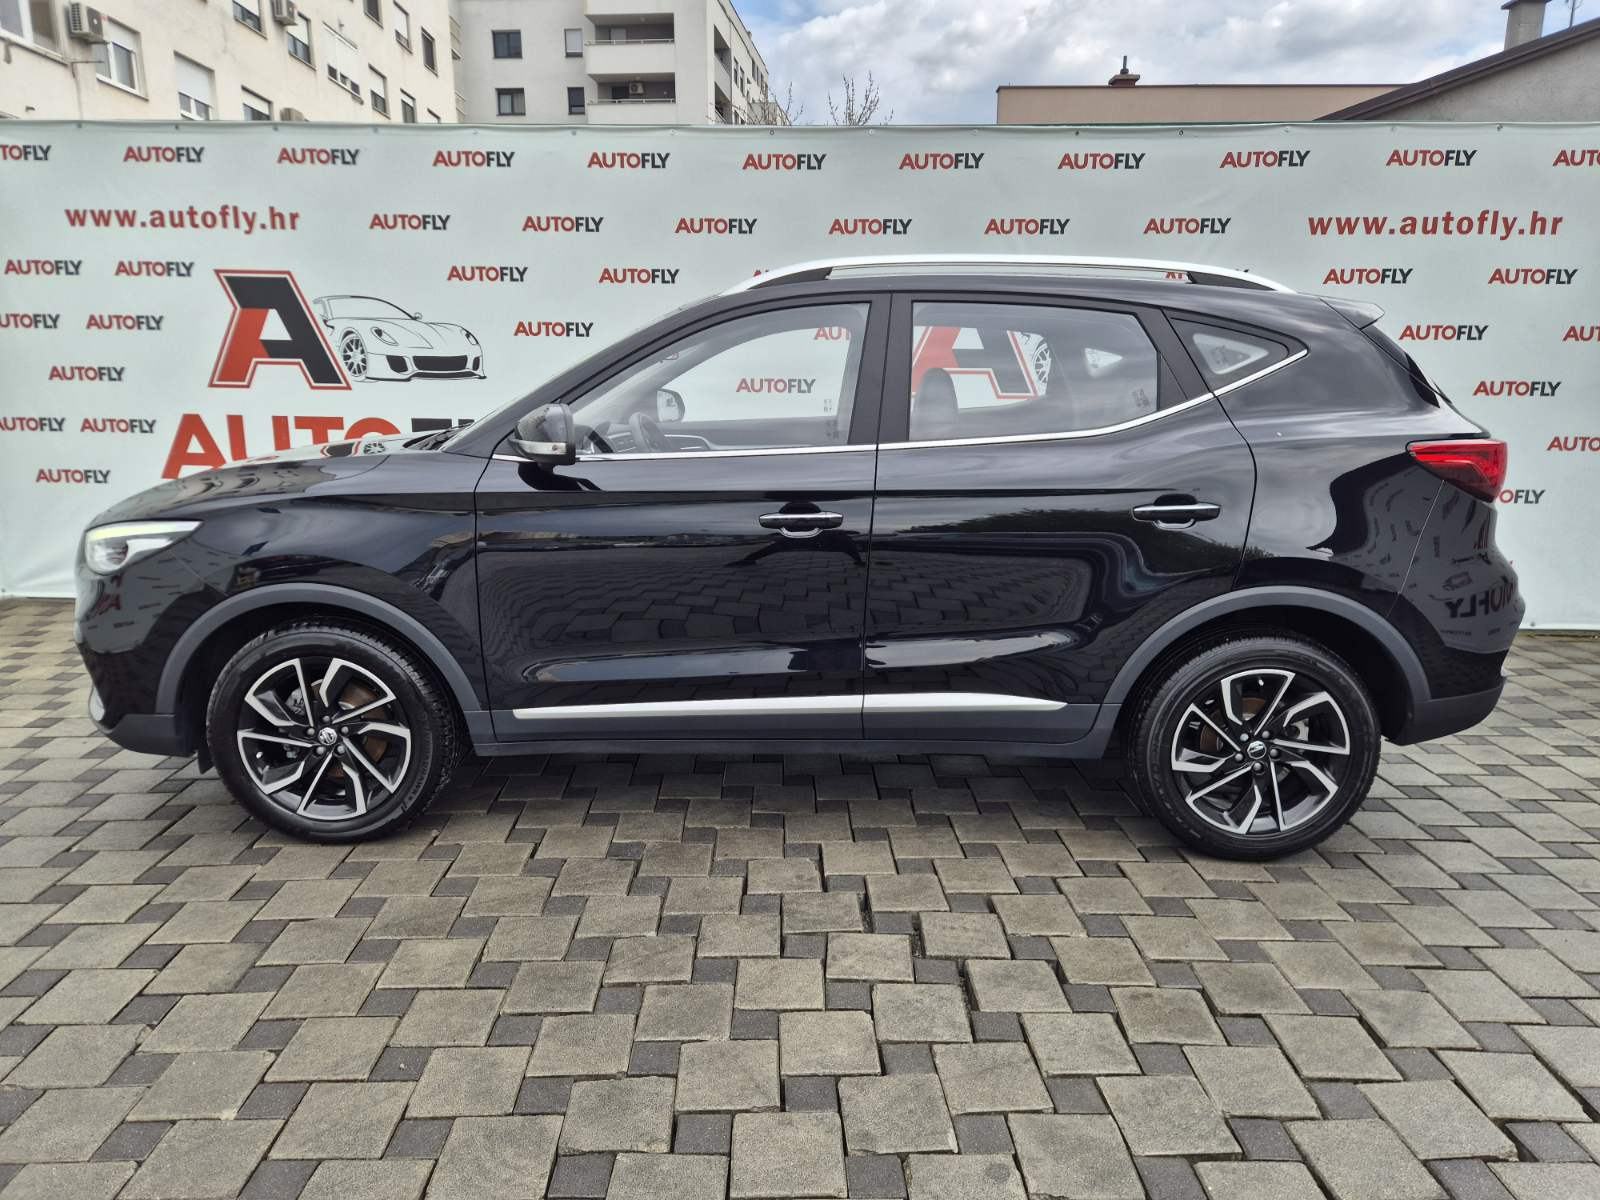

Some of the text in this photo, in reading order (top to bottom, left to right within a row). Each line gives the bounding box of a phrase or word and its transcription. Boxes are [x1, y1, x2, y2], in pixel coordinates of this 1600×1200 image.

[0, 145, 51, 160] TOFLY
[124, 147, 204, 163] AUTOFLY
[278, 148, 360, 165] AUTOFLY
[433, 151, 515, 167] AUTOFLY
[588, 152, 670, 168] AUTOFLY
[1220, 150, 1310, 168] AUTOFLY
[1386, 150, 1477, 166] AUTOFLY
[1553, 150, 1600, 166] AUT
[743, 154, 826, 170] AUTOFLY
[899, 153, 984, 169] AUTOFLY
[1058, 153, 1145, 169] AUTOFLY
[64, 205, 299, 234] www.autofly.hr
[369, 214, 450, 230] AUTOFLY
[522, 216, 603, 232] AUTOFLY
[675, 218, 757, 234] AUTOFLY
[829, 219, 912, 235] AUTOFLY
[985, 219, 1070, 234] AUTOFLY
[1144, 218, 1231, 234] AUTOFLY
[1308, 210, 1563, 240] www.autofly.hr
[5, 260, 82, 275] AUTOFLY
[115, 261, 194, 277] AUTOFLY
[447, 266, 528, 282] AUTOFLY
[599, 268, 679, 284] AUTOFLY
[1323, 268, 1413, 284] AUTOFLY
[1488, 269, 1578, 284] AUTOFLY
[86, 315, 164, 330] AUTOFLY
[514, 322, 593, 337] AUTOFLY
[1399, 325, 1488, 341] AUTOFLY
[49, 366, 125, 381] AUTOFLY
[736, 378, 816, 393] AUTOFLY
[1473, 381, 1561, 396] AUTOFLY
[80, 418, 156, 433] AUTOFLY
[36, 469, 110, 483] AUTOFLY
[1500, 489, 1546, 505] OFLY
